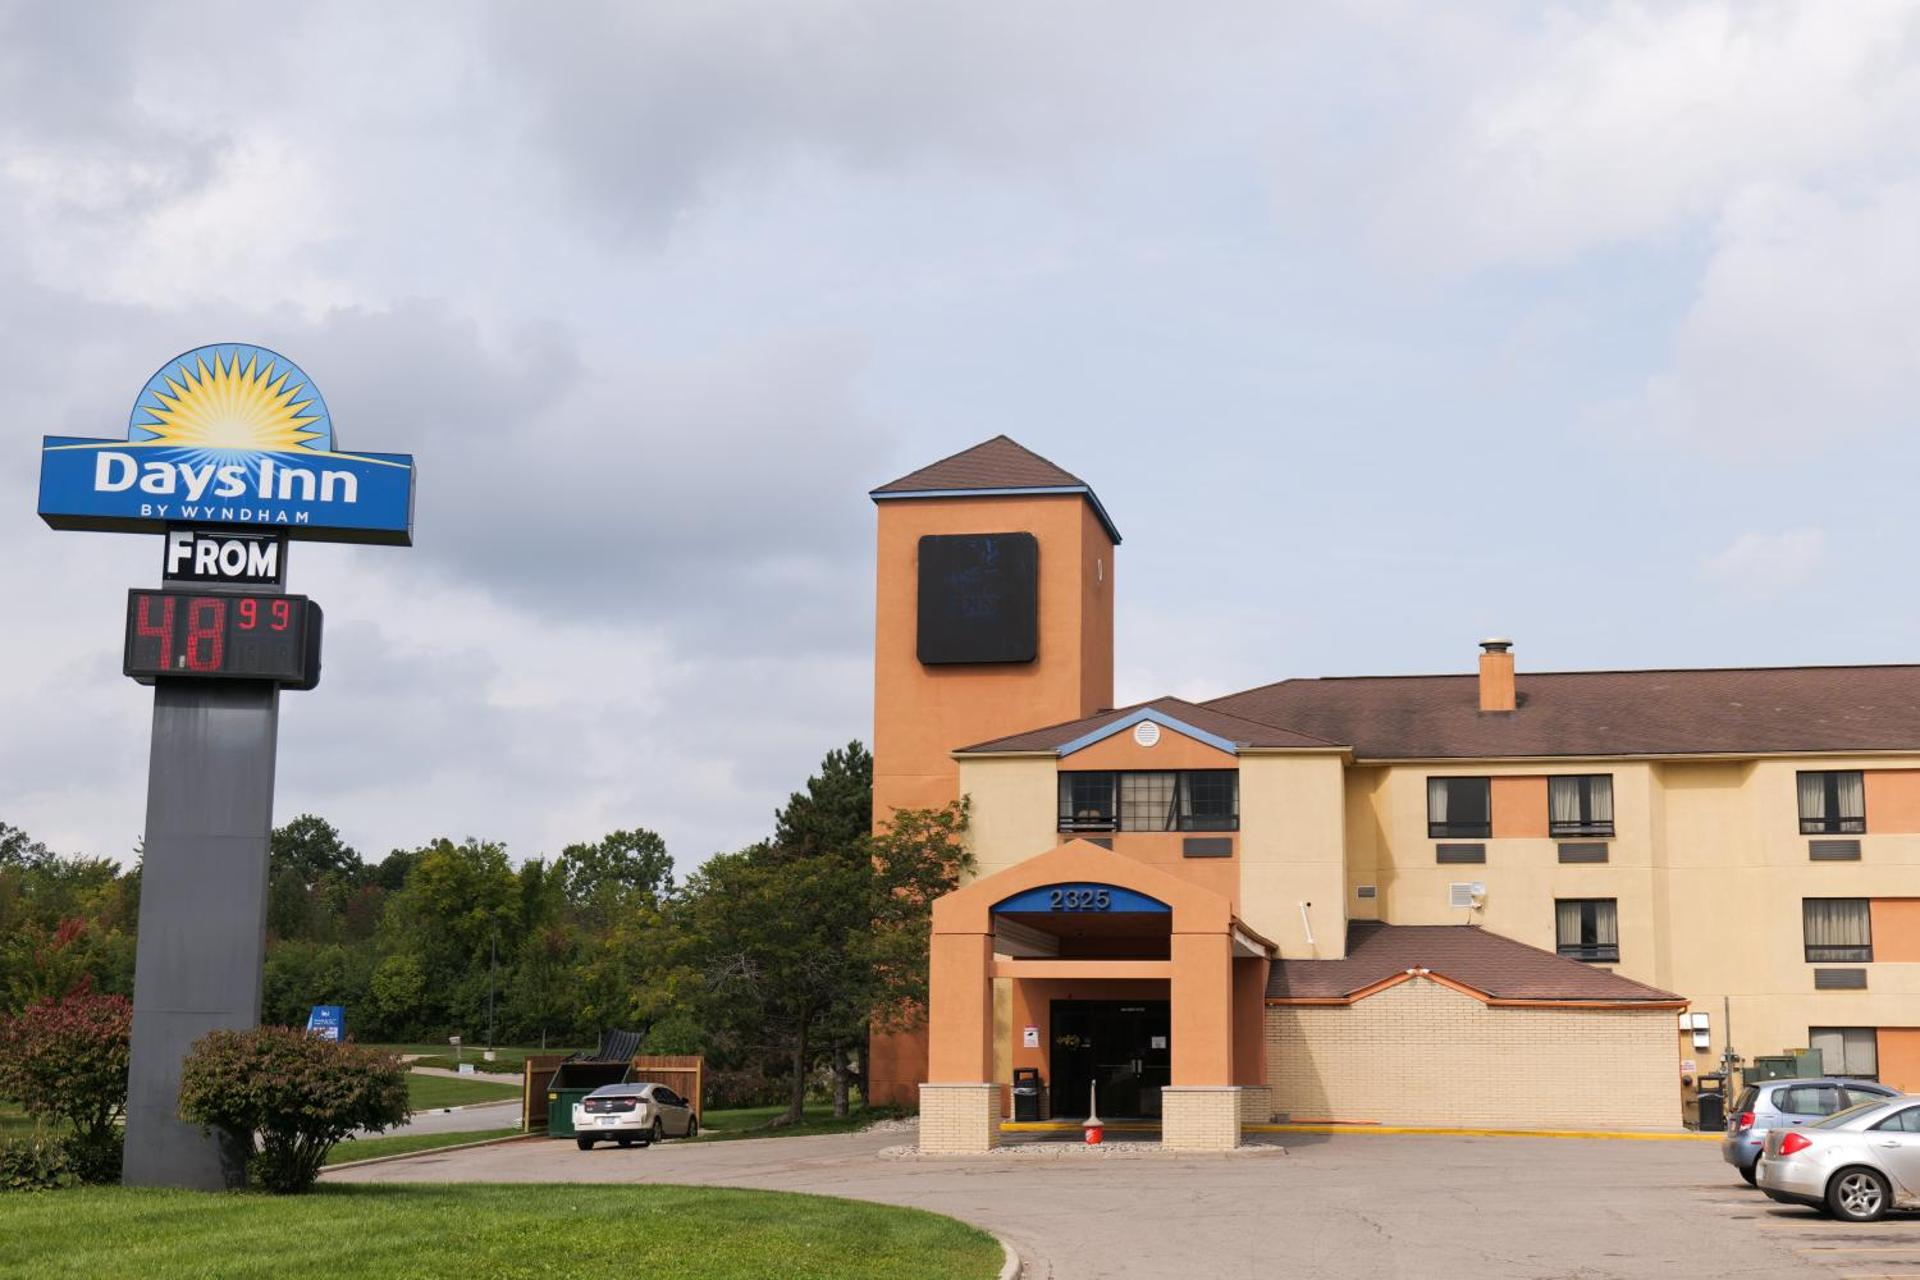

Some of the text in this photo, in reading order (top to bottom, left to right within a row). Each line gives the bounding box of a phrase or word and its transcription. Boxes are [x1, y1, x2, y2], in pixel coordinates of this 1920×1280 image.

[95, 452, 358, 502] Days Inn
[141, 504, 309, 523] BY WYNDHAM
[167, 531, 278, 577] FROM
[1050, 889, 1110, 908] 2325
